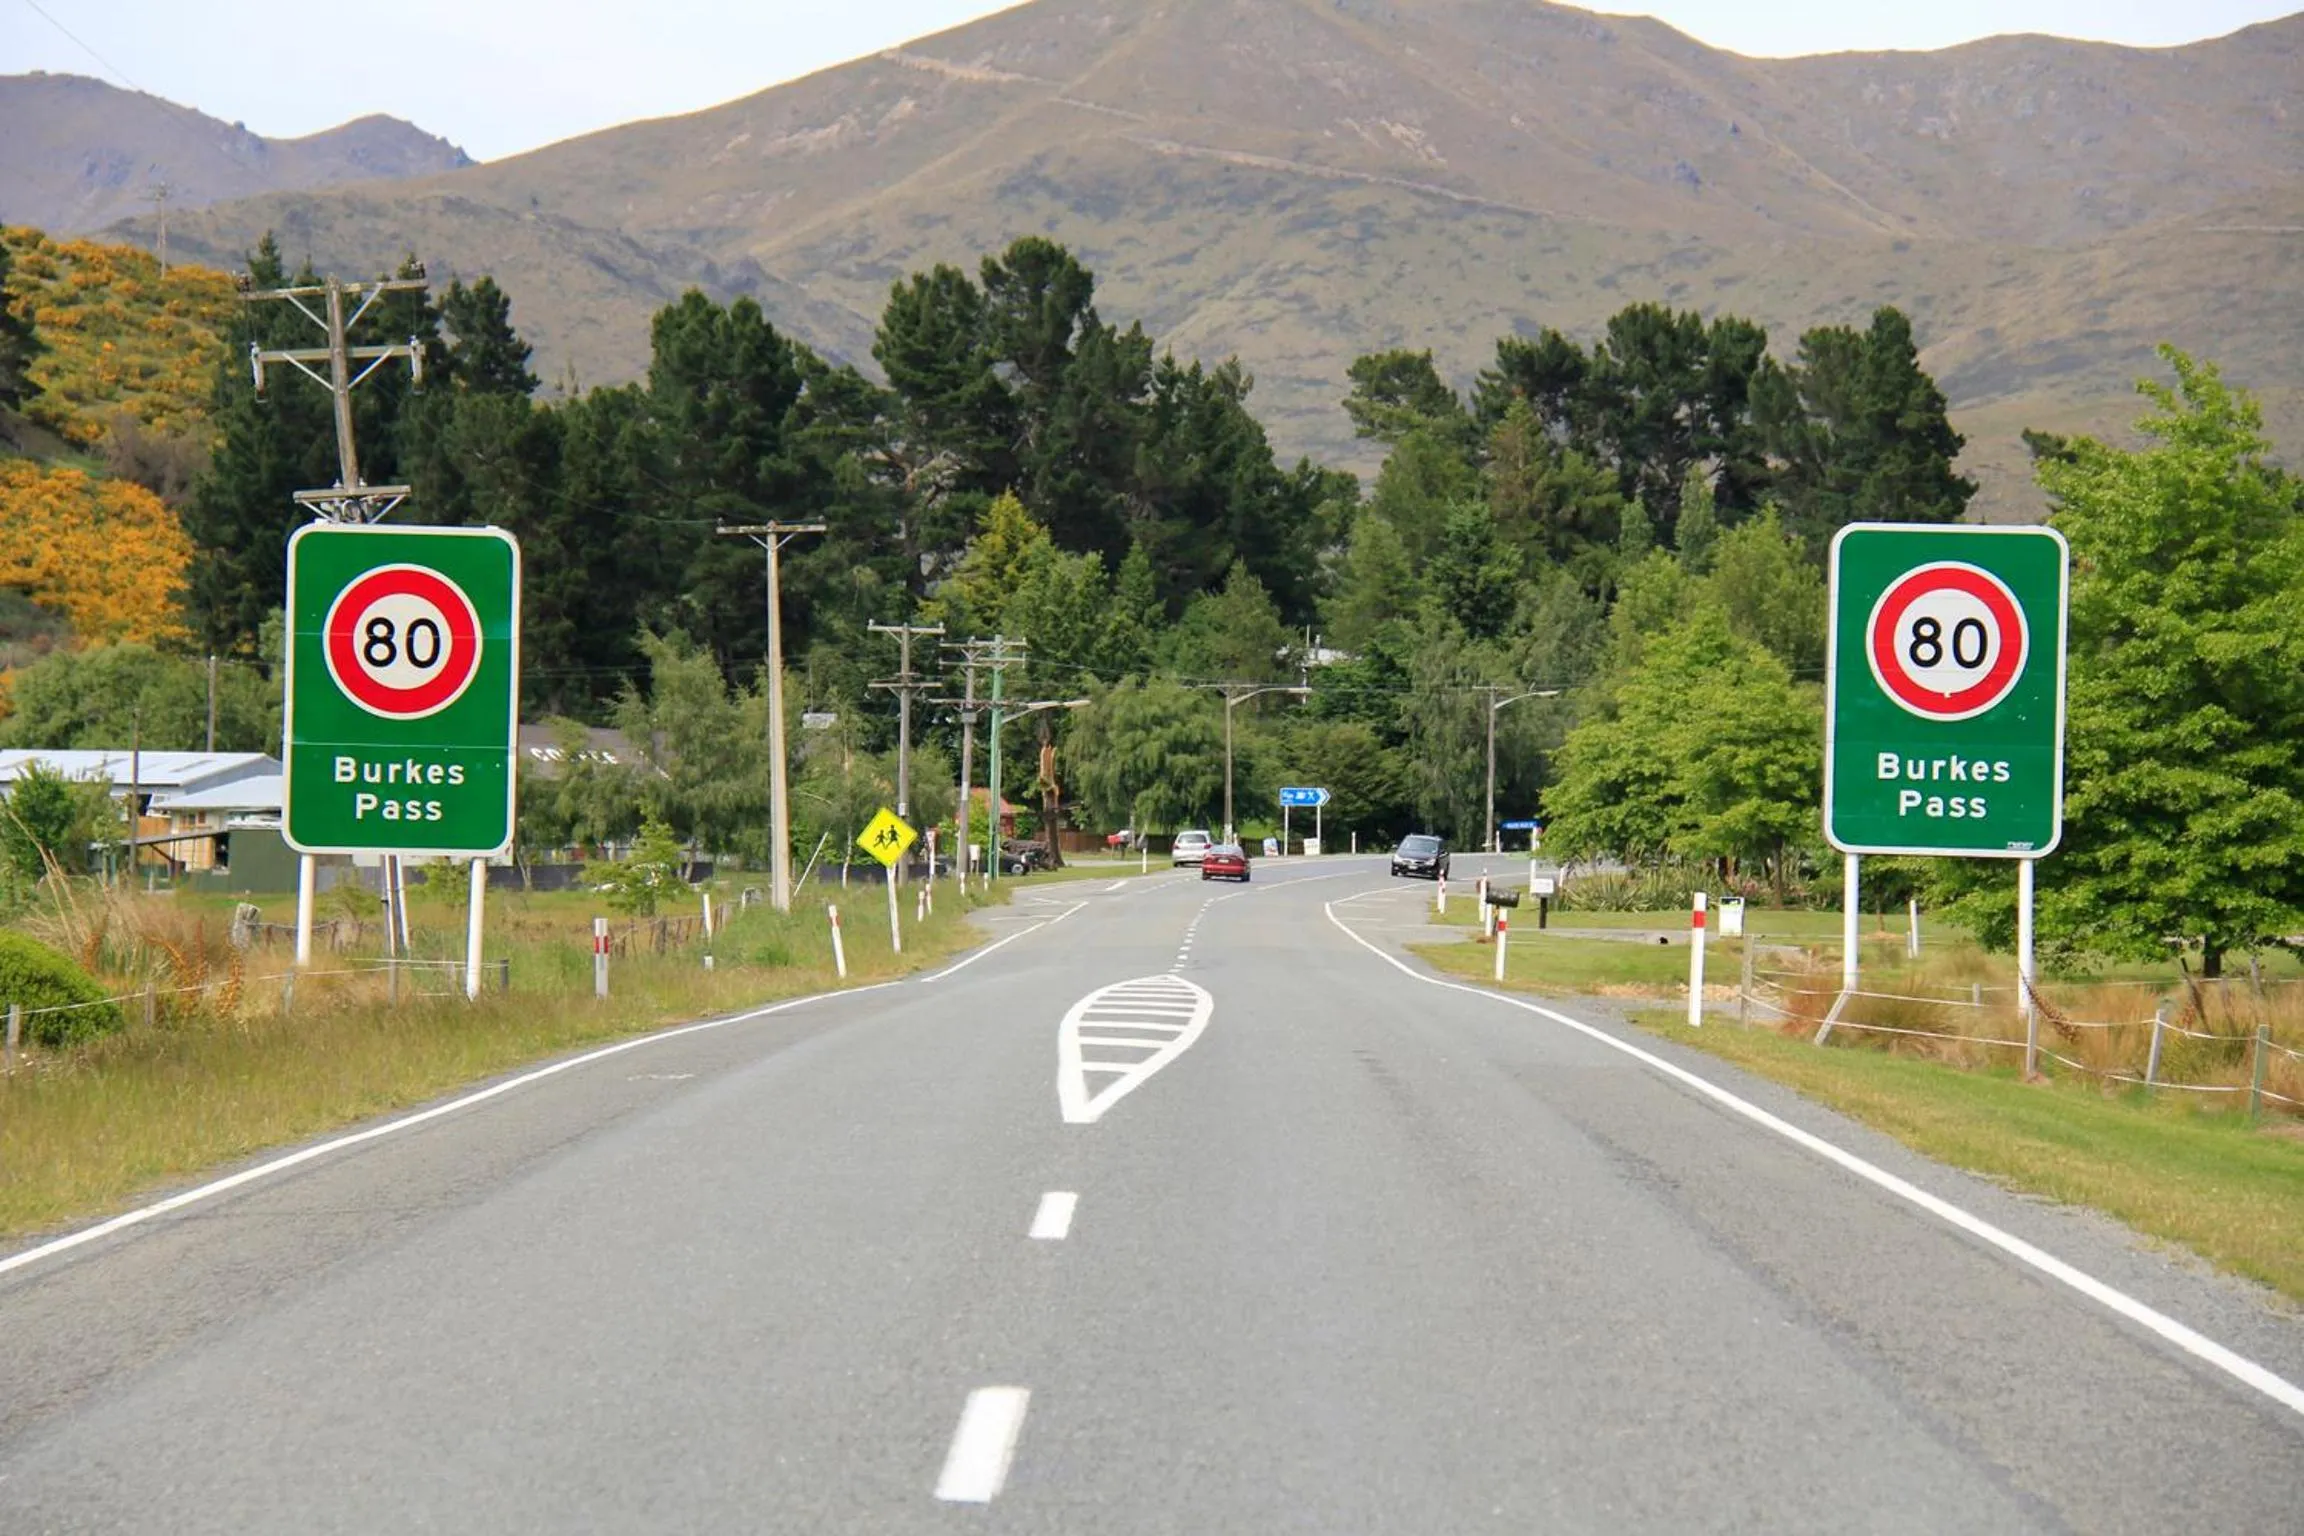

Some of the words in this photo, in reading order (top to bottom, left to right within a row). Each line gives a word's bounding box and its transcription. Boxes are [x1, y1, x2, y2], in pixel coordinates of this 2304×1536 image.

[363, 616, 441, 669] 80
[1909, 616, 1988, 669] 80
[334, 756, 465, 785] Burkes
[1877, 752, 2010, 782] Burkes
[355, 793, 442, 820] Pass
[1899, 789, 1987, 818] Pass
